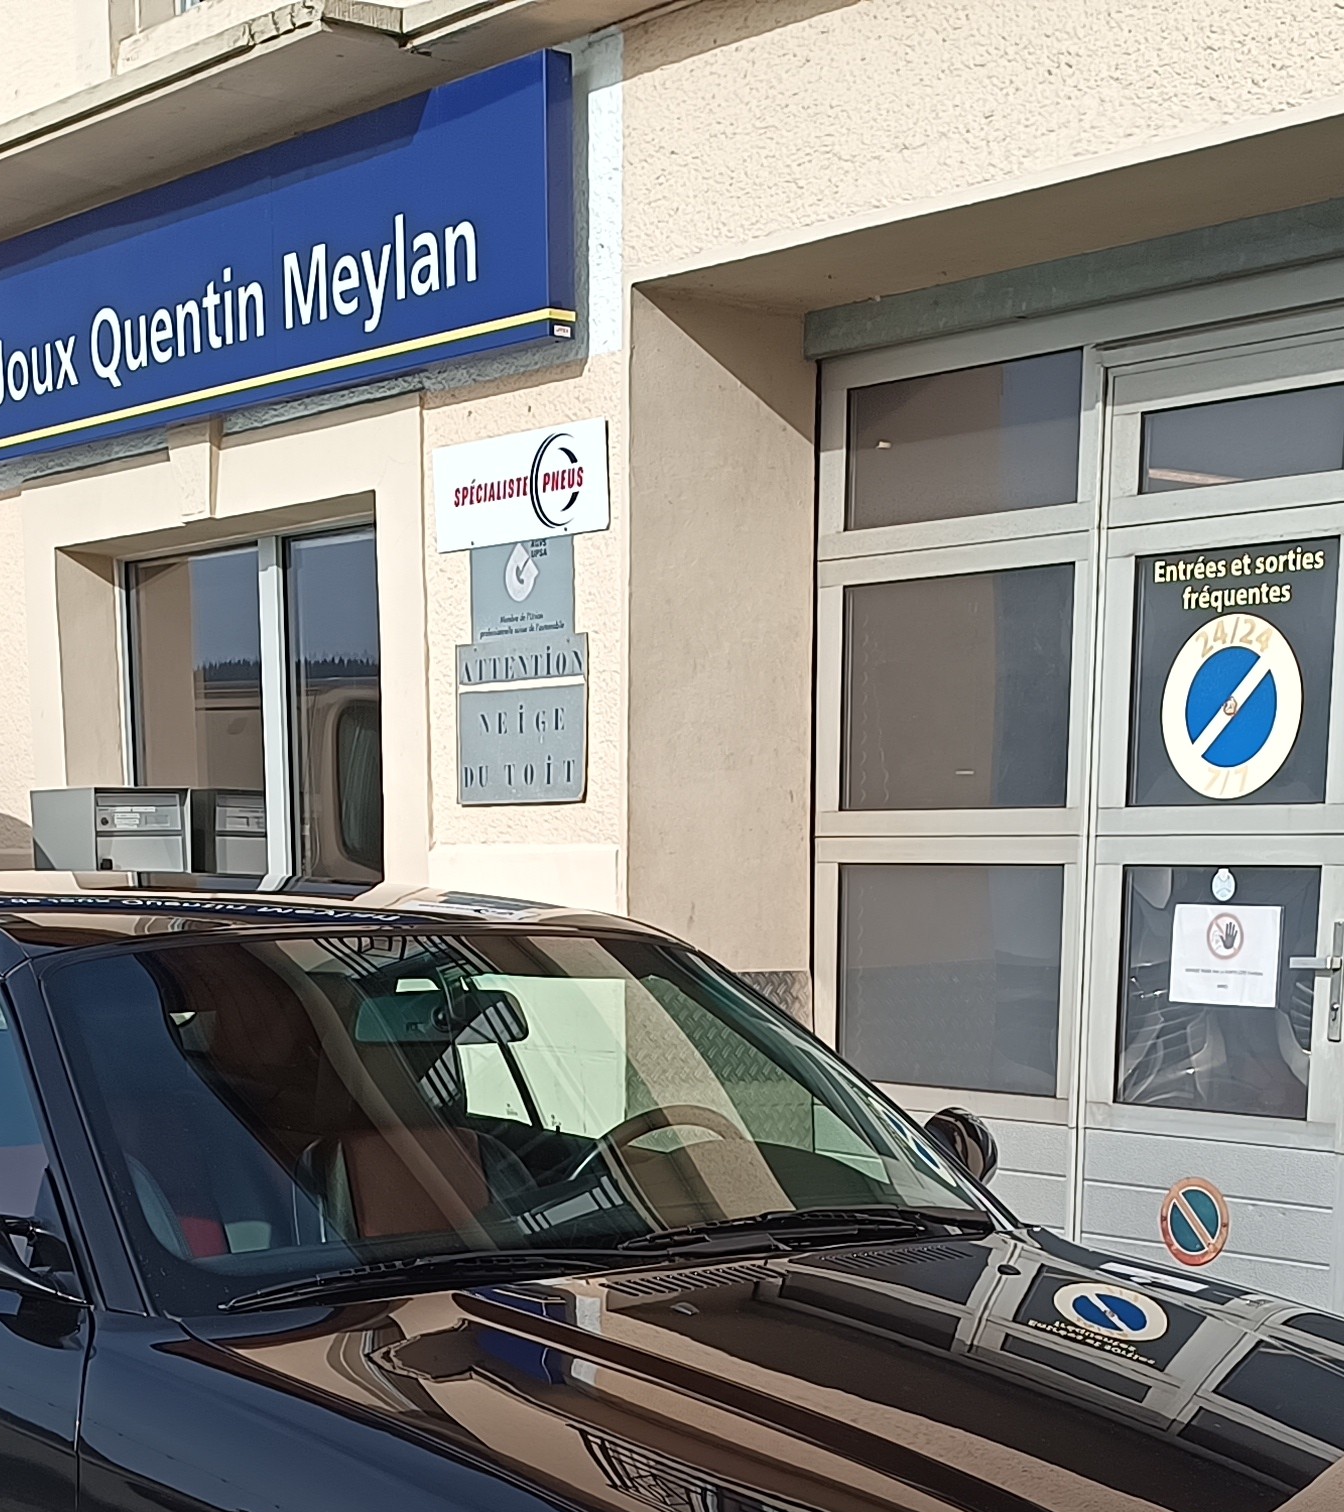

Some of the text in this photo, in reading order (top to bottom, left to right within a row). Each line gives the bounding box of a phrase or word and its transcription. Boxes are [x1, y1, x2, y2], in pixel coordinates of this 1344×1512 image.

[90, 266, 265, 388] Quentin
[282, 213, 478, 333] Meylan
[454, 467, 584, 507] SPÉCIALISTE PNEUS
[1154, 547, 1325, 583] Entrées et sorties
[1182, 582, 1291, 612] fréquentes
[480, 705, 565, 735] NEIGE
[464, 765, 488, 788] DU
